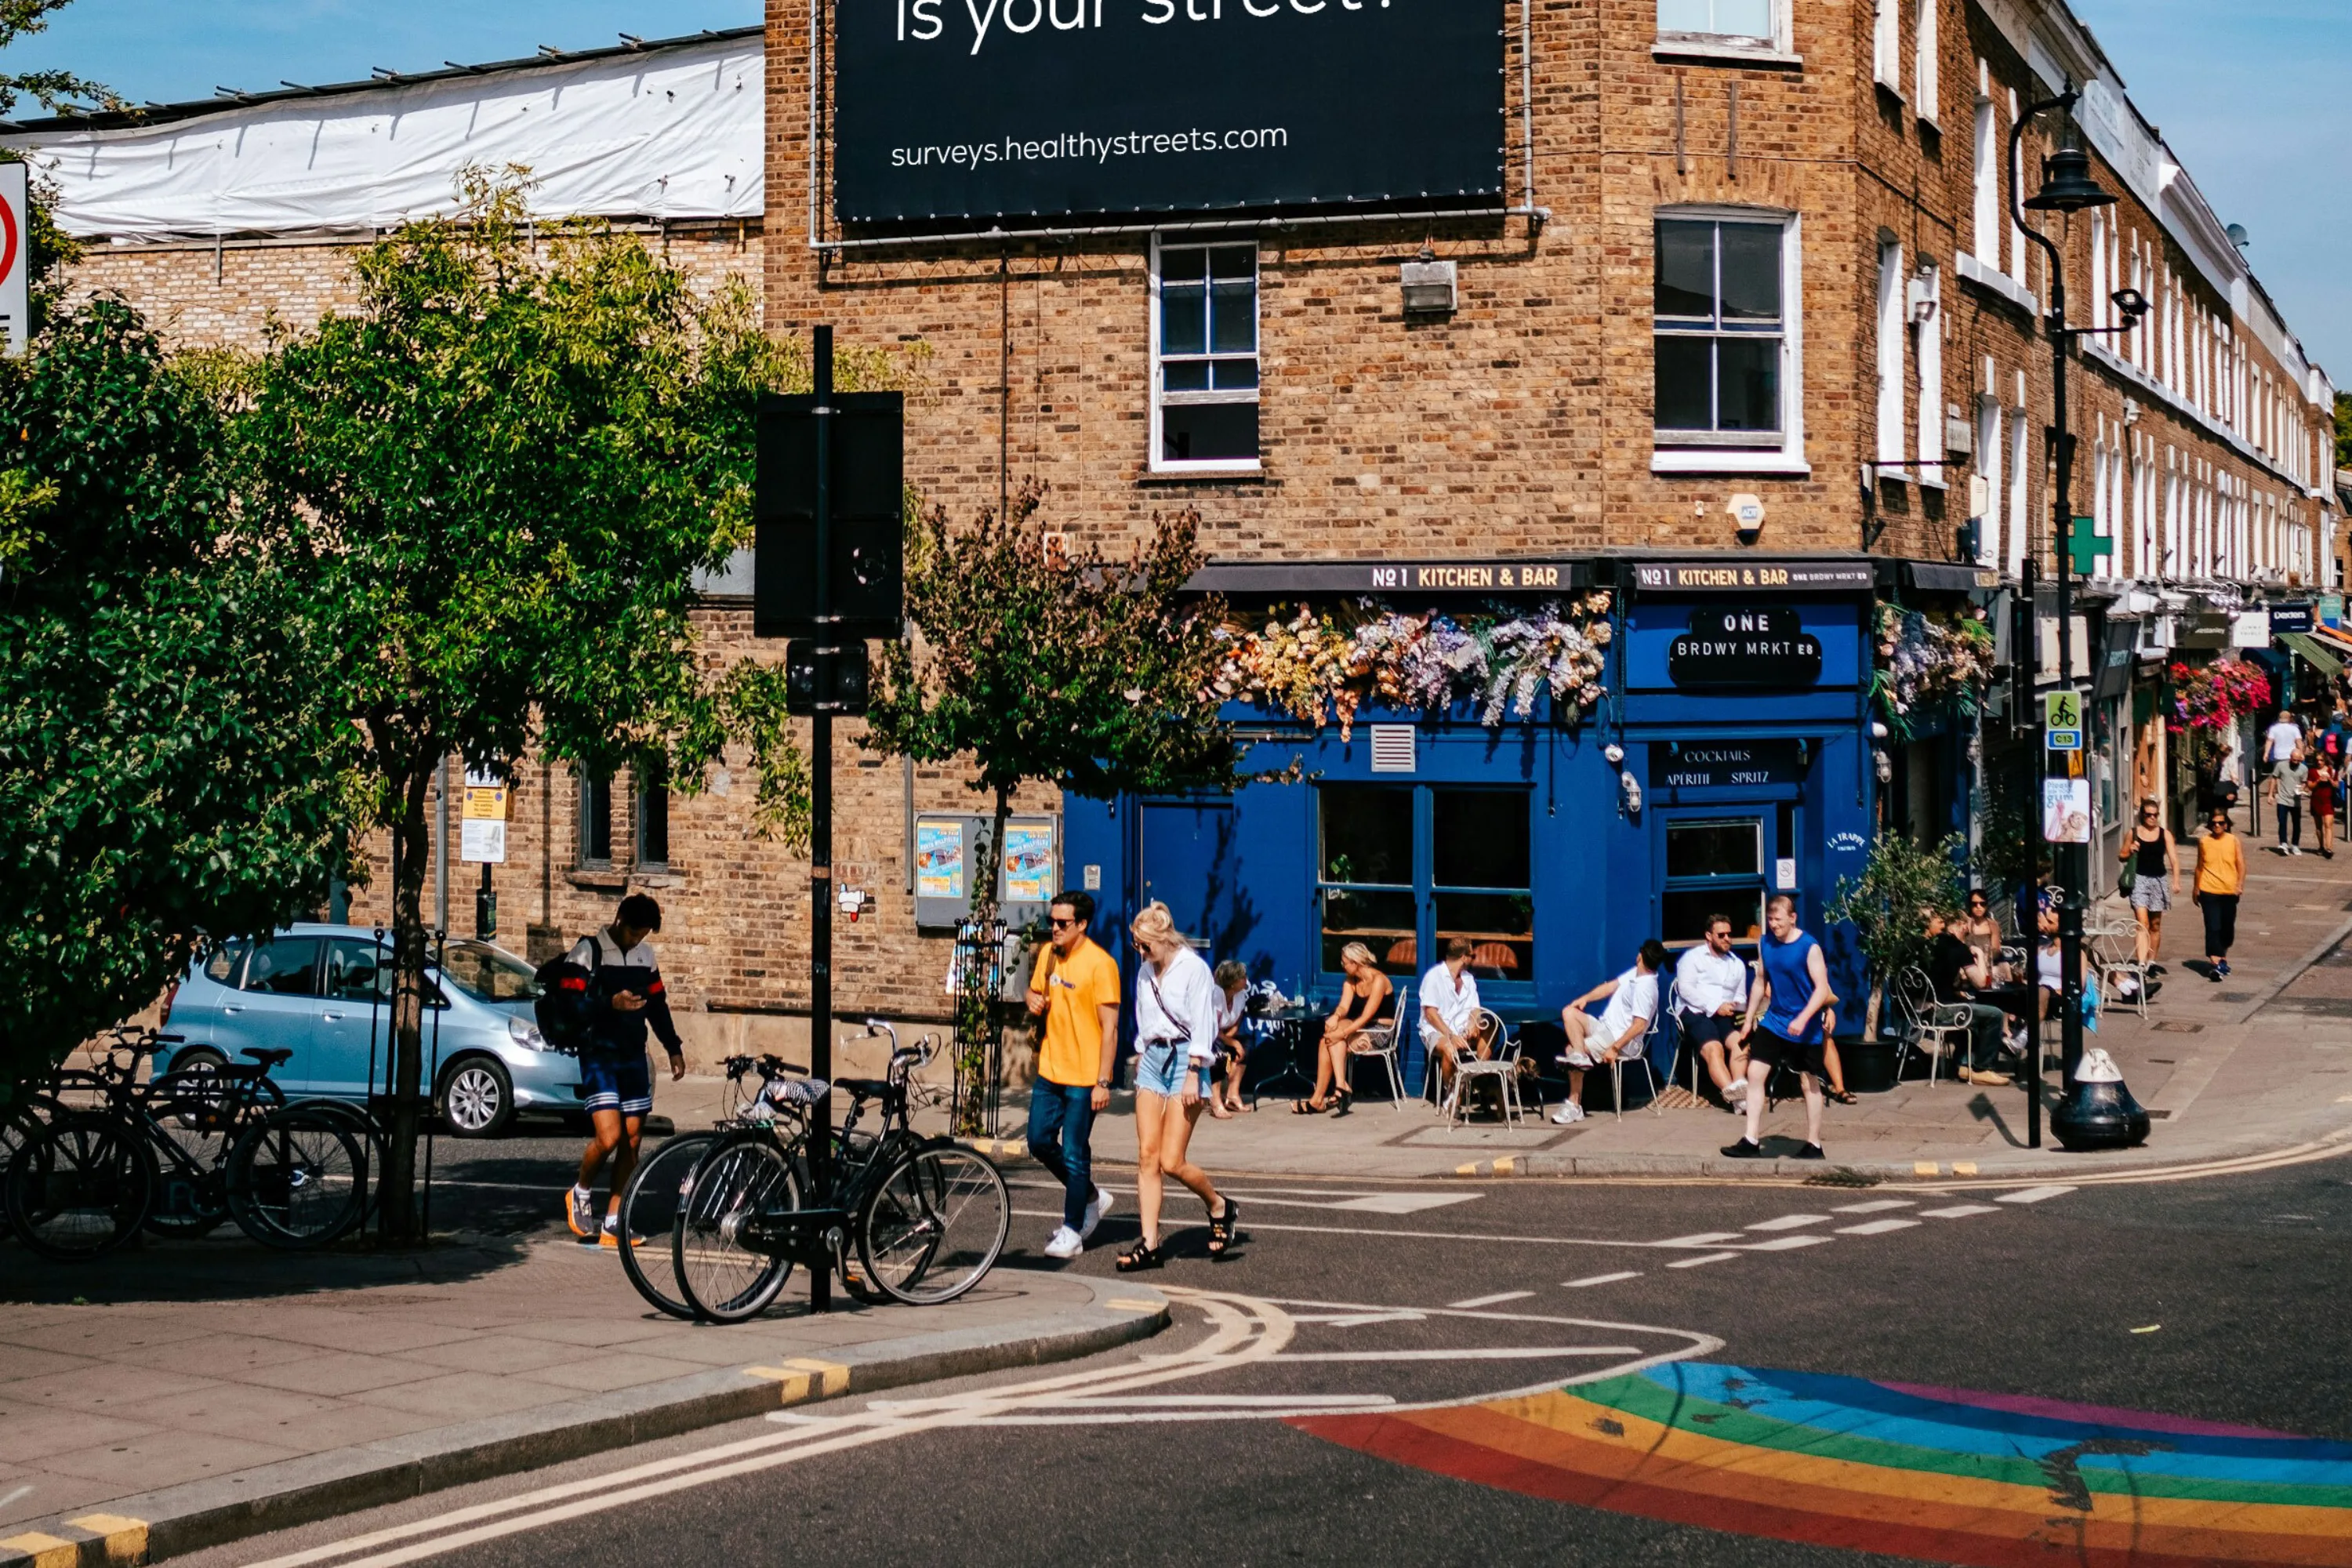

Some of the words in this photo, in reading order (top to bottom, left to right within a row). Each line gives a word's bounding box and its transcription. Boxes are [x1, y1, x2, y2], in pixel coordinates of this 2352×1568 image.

[897, 0, 943, 41] is
[891, 127, 1288, 171] surveys.healthystreets.com
[1418, 568, 1493, 587] KITCHEN
[1499, 568, 1515, 586] &
[1521, 567, 1559, 586] BAR
[1678, 569, 1738, 586] KITCHEN
[1743, 569, 1756, 585] &
[1760, 568, 1789, 586] BAR
[1724, 614, 1769, 632] ONE
[1677, 642, 1737, 656] BRDWY
[1746, 641, 1791, 655] MRKT
[1798, 644, 1813, 655] E8
[1684, 750, 1751, 763] COCKTAILS
[1731, 771, 1769, 784] SPRITZ
[1827, 837, 1838, 849] LA
